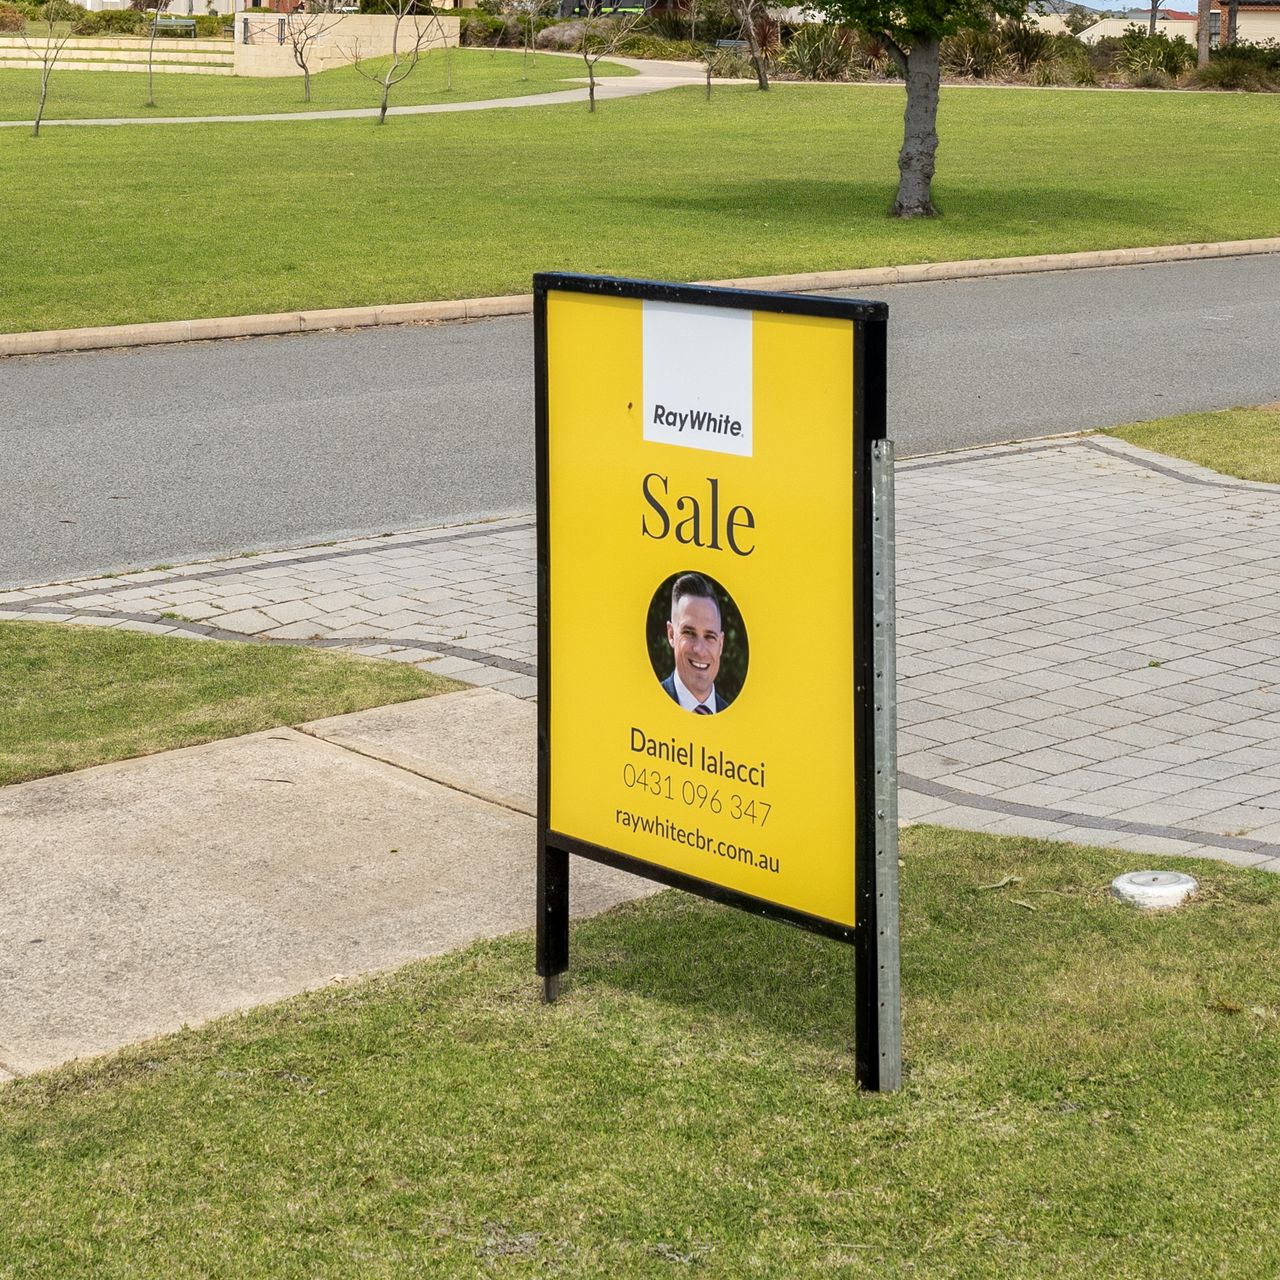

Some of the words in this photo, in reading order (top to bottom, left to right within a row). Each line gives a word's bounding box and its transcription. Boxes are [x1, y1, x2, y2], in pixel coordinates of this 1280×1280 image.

[653, 405, 743, 437] RayWhite
[642, 473, 755, 557] Sale
[631, 727, 694, 768] Daniel
[623, 763, 674, 801] 0431
[682, 780, 722, 814] 096
[730, 794, 771, 828] 347
[616, 809, 779, 874] raywhitecbr.com.au
